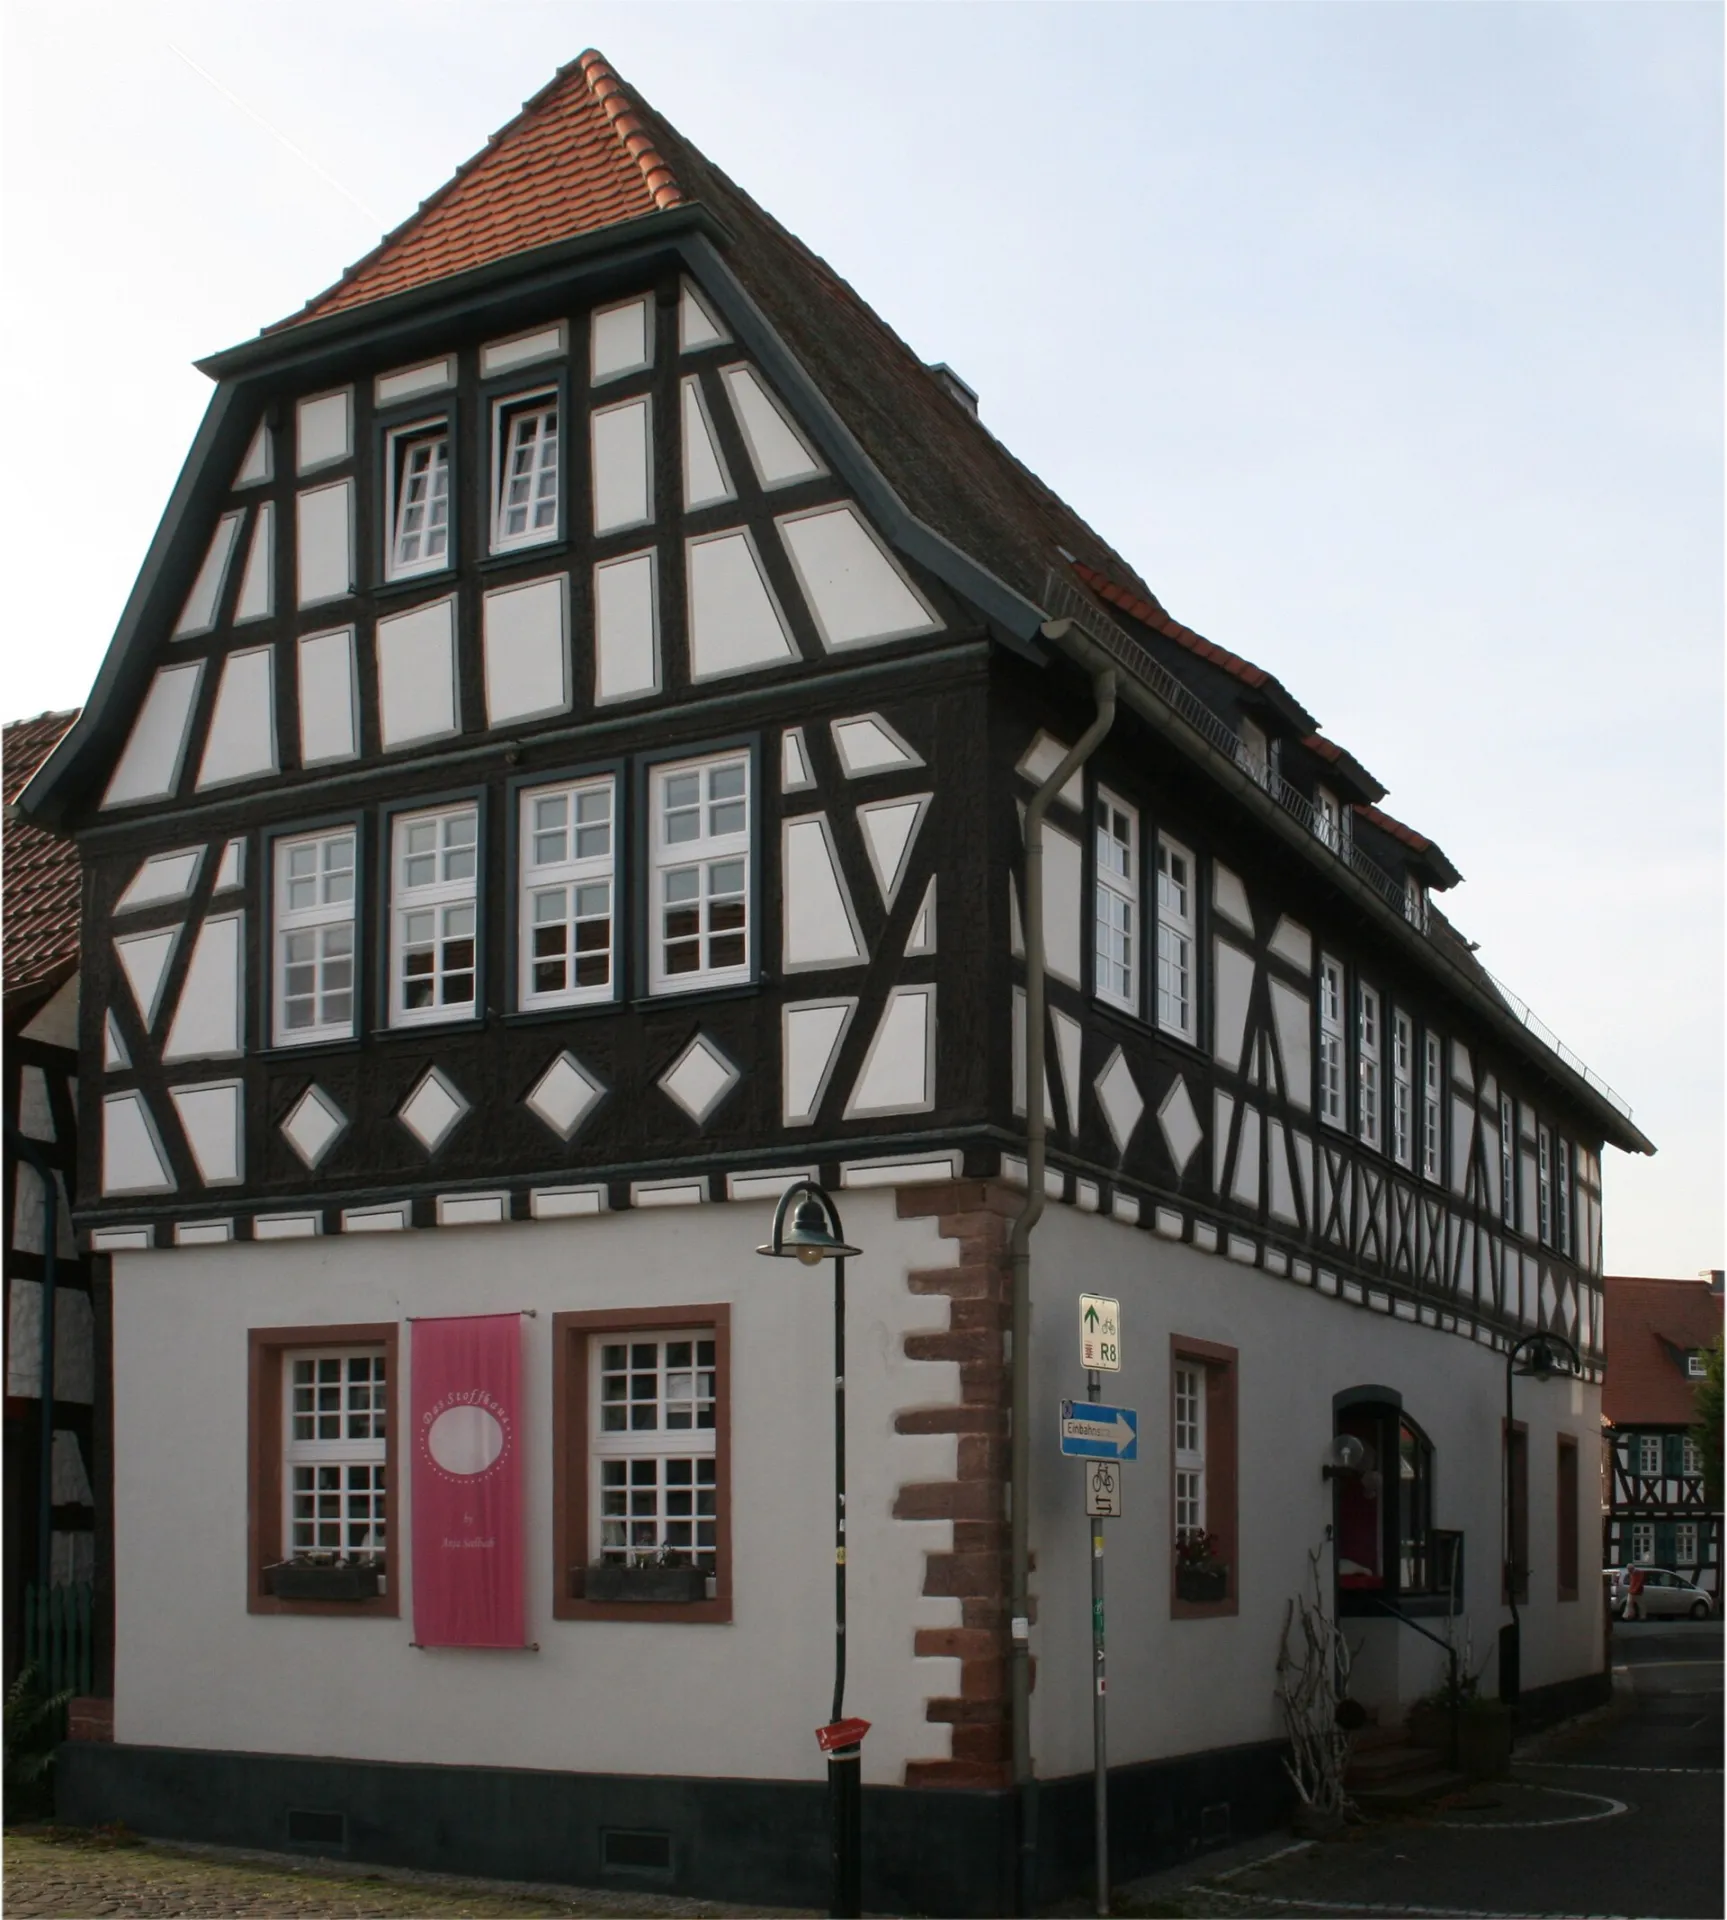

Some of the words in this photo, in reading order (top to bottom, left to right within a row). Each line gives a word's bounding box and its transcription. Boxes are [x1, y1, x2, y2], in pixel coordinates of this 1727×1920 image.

[1100, 1342, 1117, 1362] R8
[422, 1400, 445, 1425] Das
[447, 1388, 511, 1424] Stoffhaus
